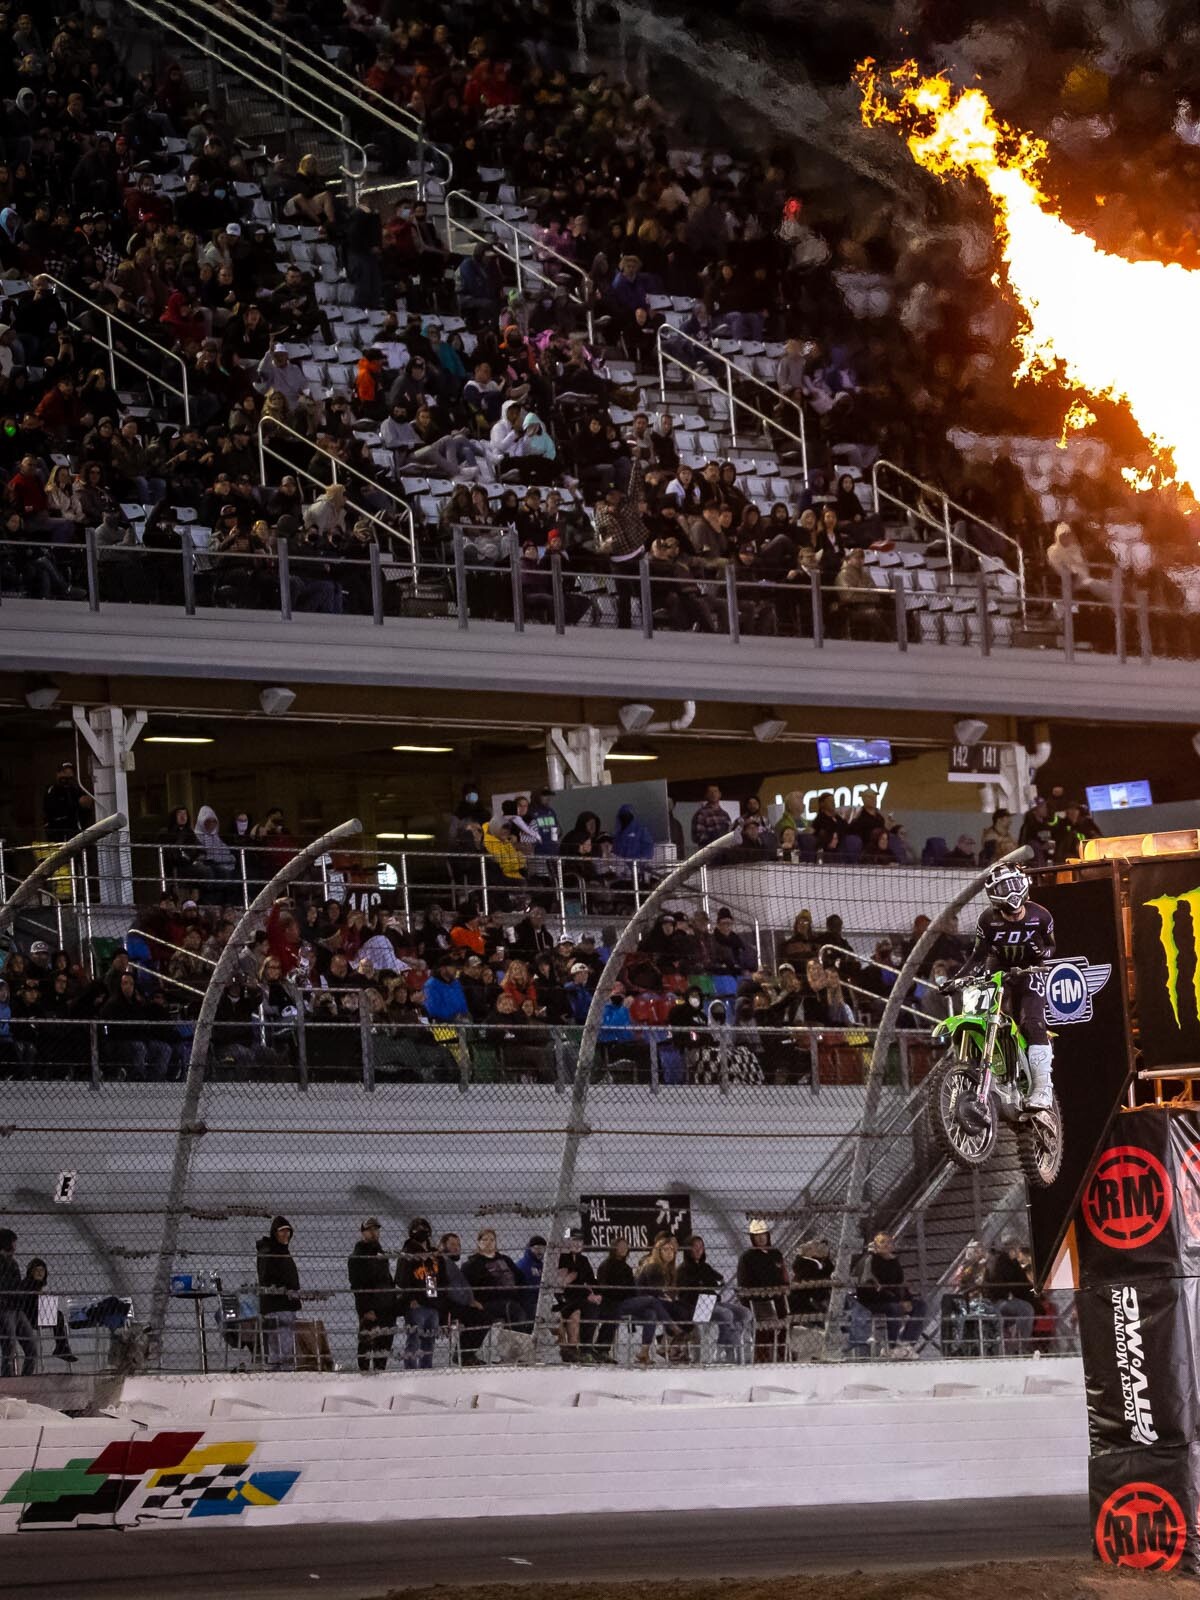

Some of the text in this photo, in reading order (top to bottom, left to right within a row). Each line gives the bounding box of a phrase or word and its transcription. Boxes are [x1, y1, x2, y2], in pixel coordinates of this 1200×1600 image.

[952, 745, 968, 767] 142
[982, 746, 997, 767] 141
[993, 930, 1036, 943] FOX
[1051, 978, 1082, 1004] FIM
[1099, 1173, 1155, 1220] RM
[589, 1199, 611, 1222] ALL
[590, 1224, 649, 1248] SECTIONS
[1111, 1289, 1136, 1422] ROCKY MOUNTAIN
[1112, 1509, 1168, 1556] RM
